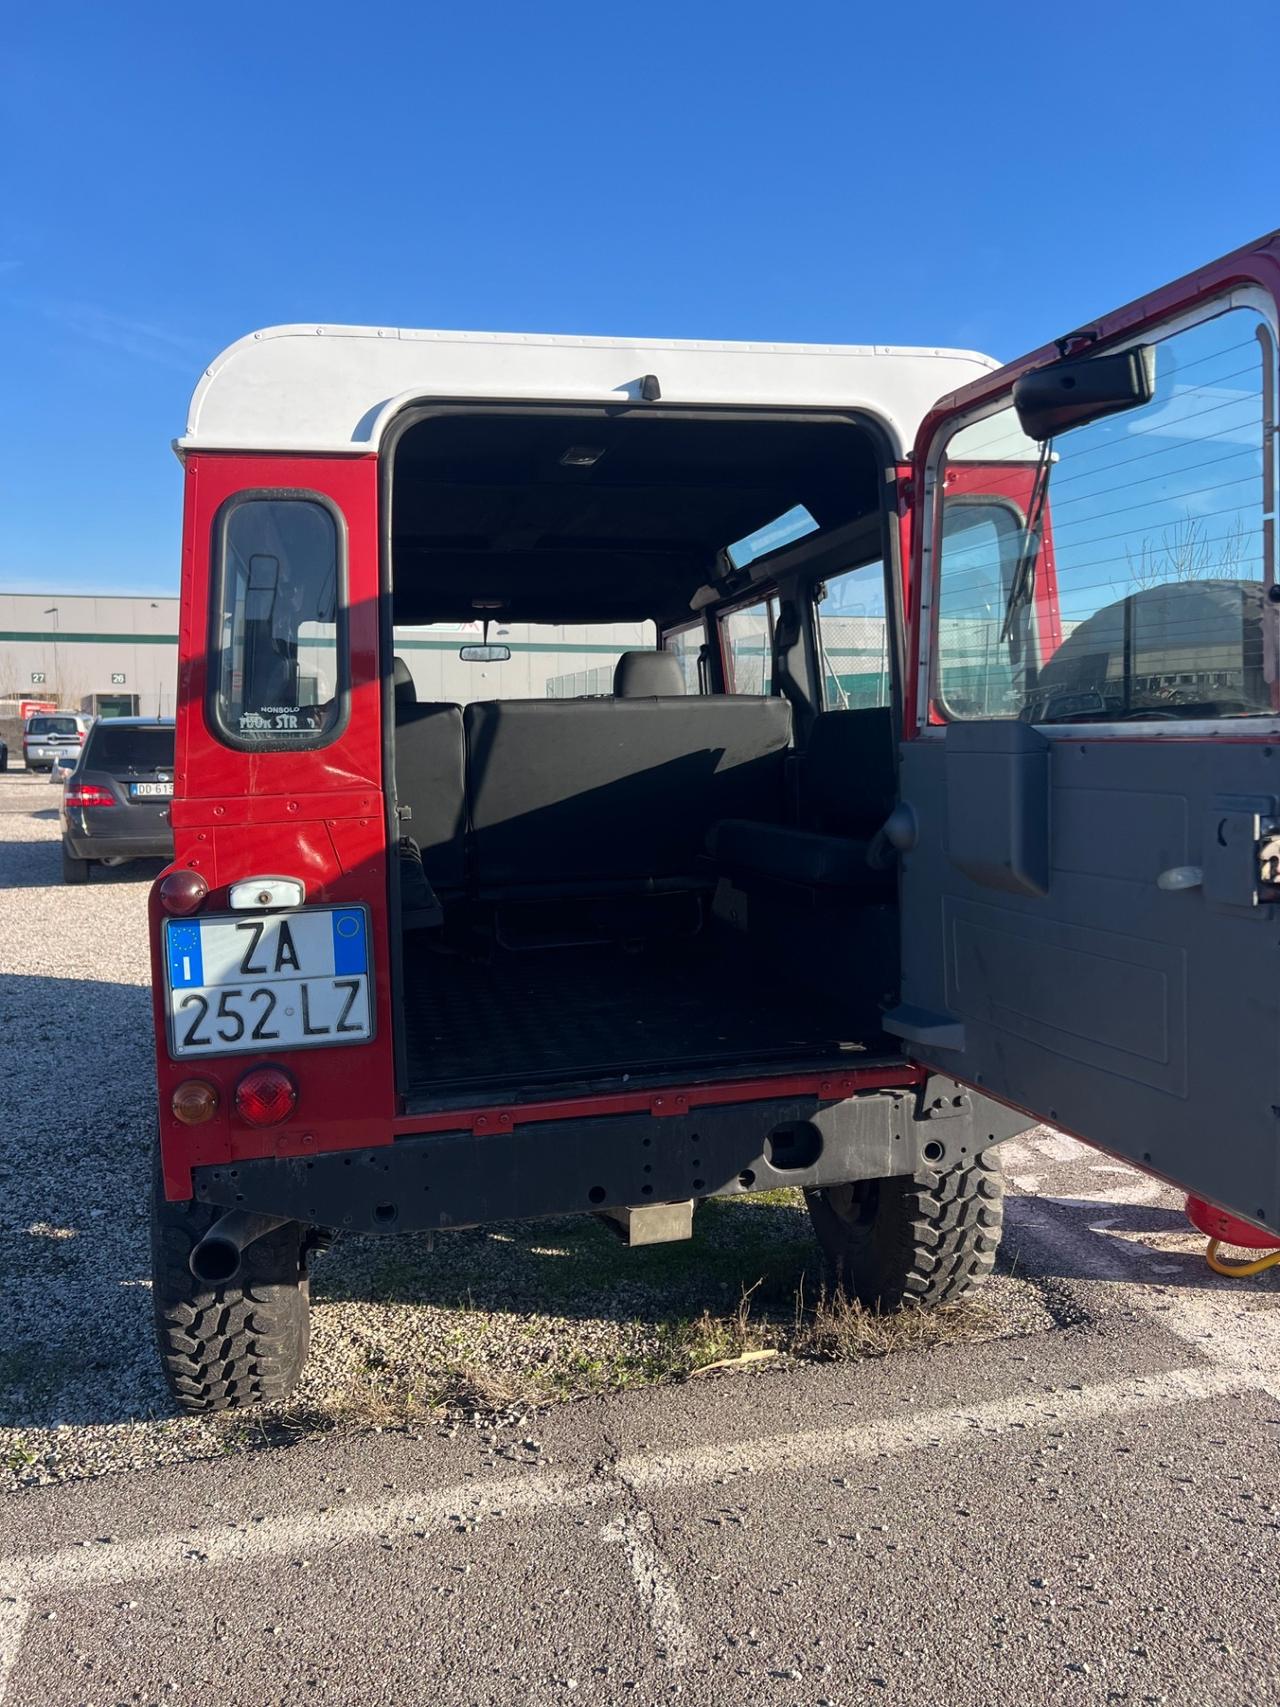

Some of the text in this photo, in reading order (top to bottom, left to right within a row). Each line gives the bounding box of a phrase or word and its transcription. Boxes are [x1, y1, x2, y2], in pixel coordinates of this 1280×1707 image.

[33, 674, 44, 683] 27
[139, 784, 152, 794] DD
[235, 920, 300, 975] ZA
[180, 980, 364, 1046] 252 LZ
